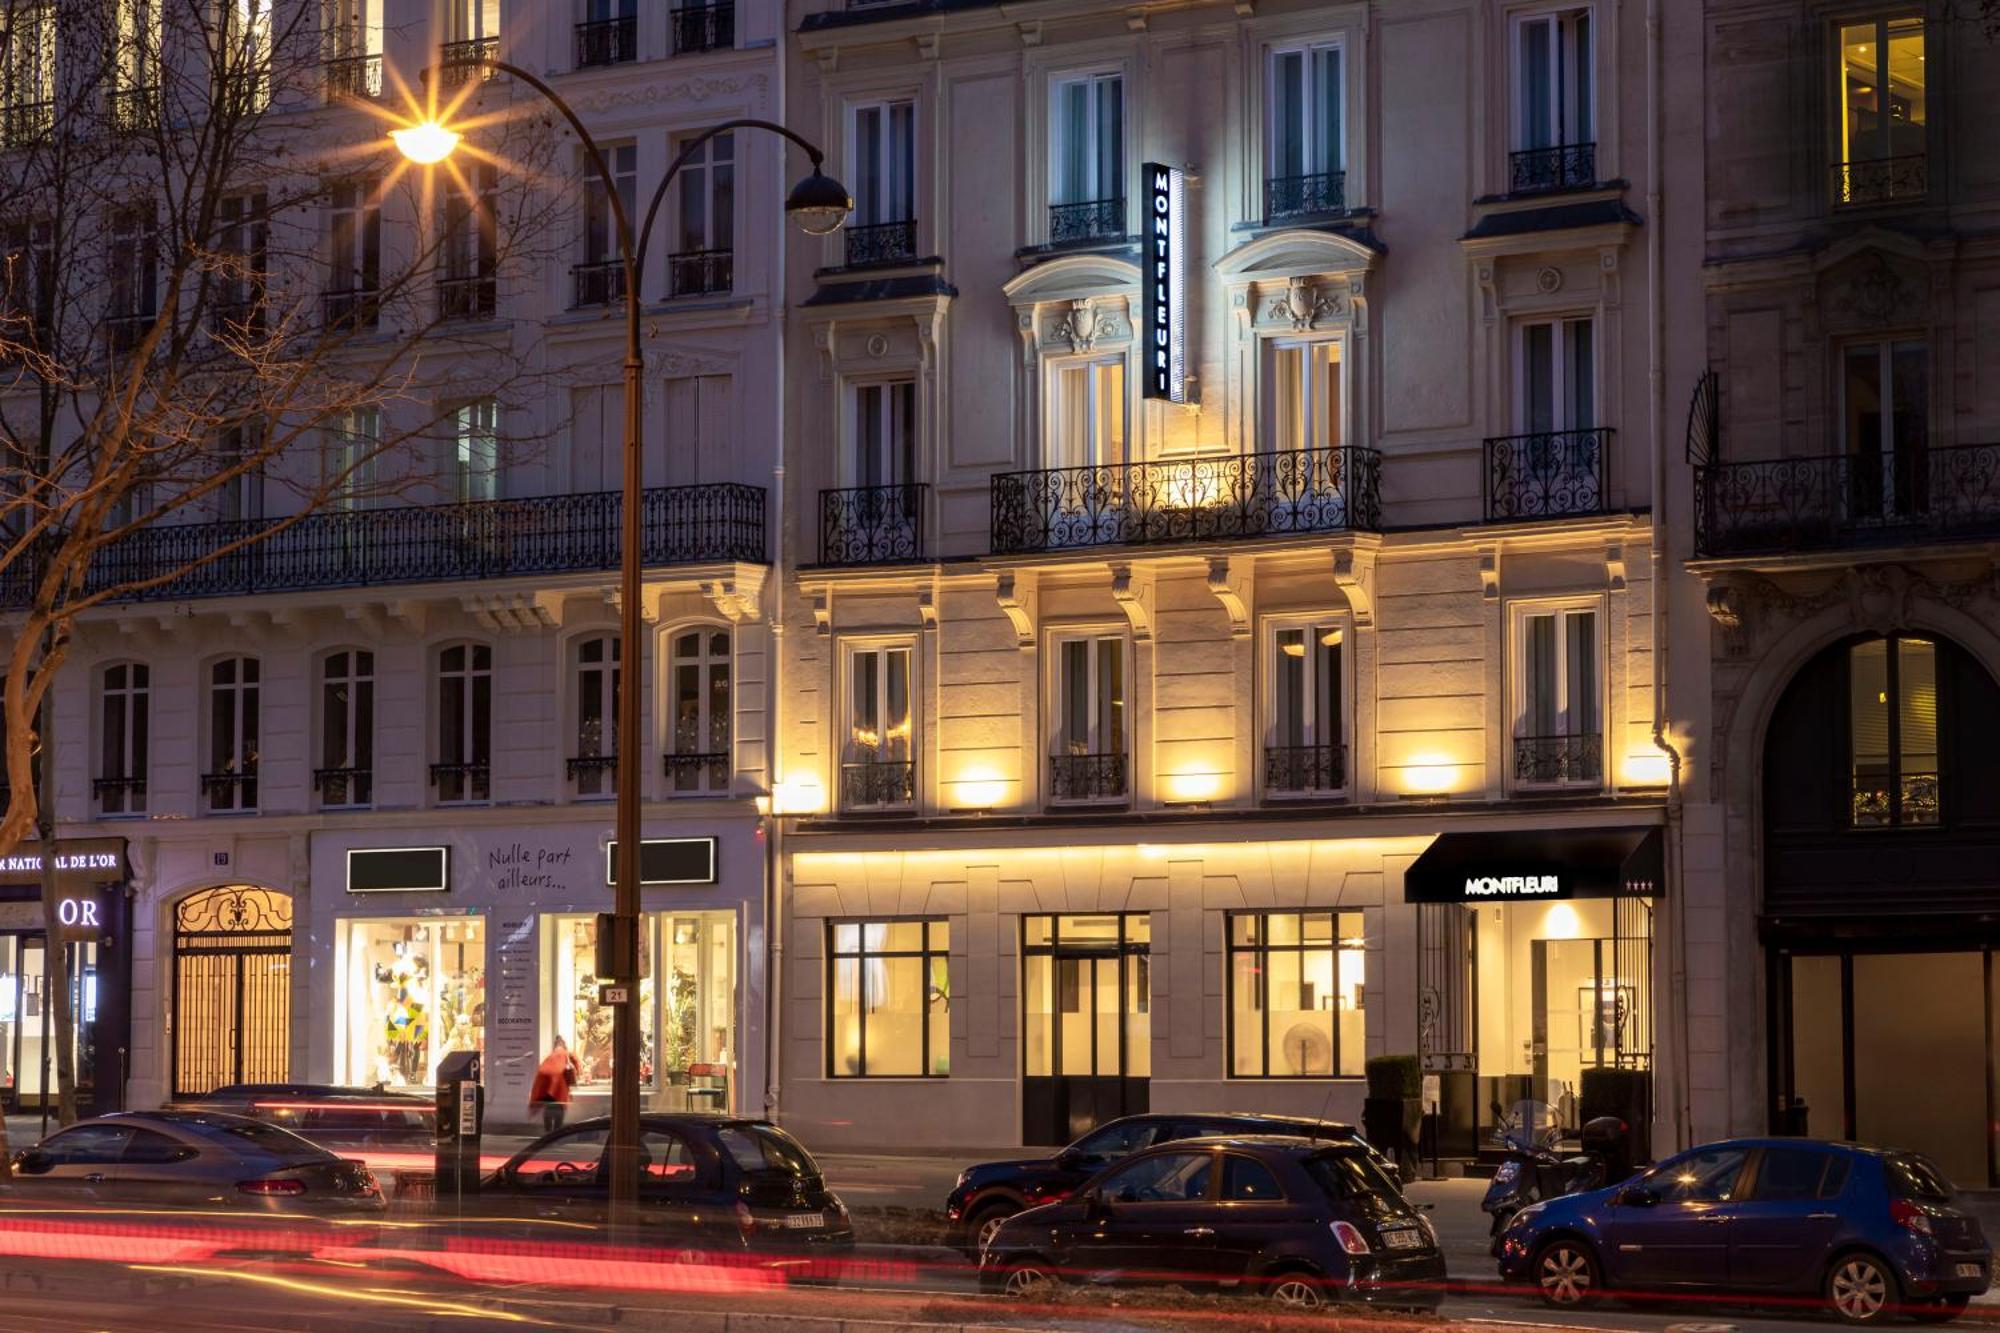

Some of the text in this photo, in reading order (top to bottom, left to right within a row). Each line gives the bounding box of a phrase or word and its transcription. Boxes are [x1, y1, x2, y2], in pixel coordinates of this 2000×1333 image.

[1155, 172, 1168, 390] MONTFLEURI
[8, 857, 68, 870] NATIOAL
[70, 855, 87, 868] DE
[89, 855, 116, 868] L'OR
[489, 843, 571, 869] Nulle part
[497, 867, 566, 889] ailleurs...
[1464, 875, 1559, 895] MONTFLEURI
[59, 899, 99, 926] OR
[610, 991, 621, 1001] 21
